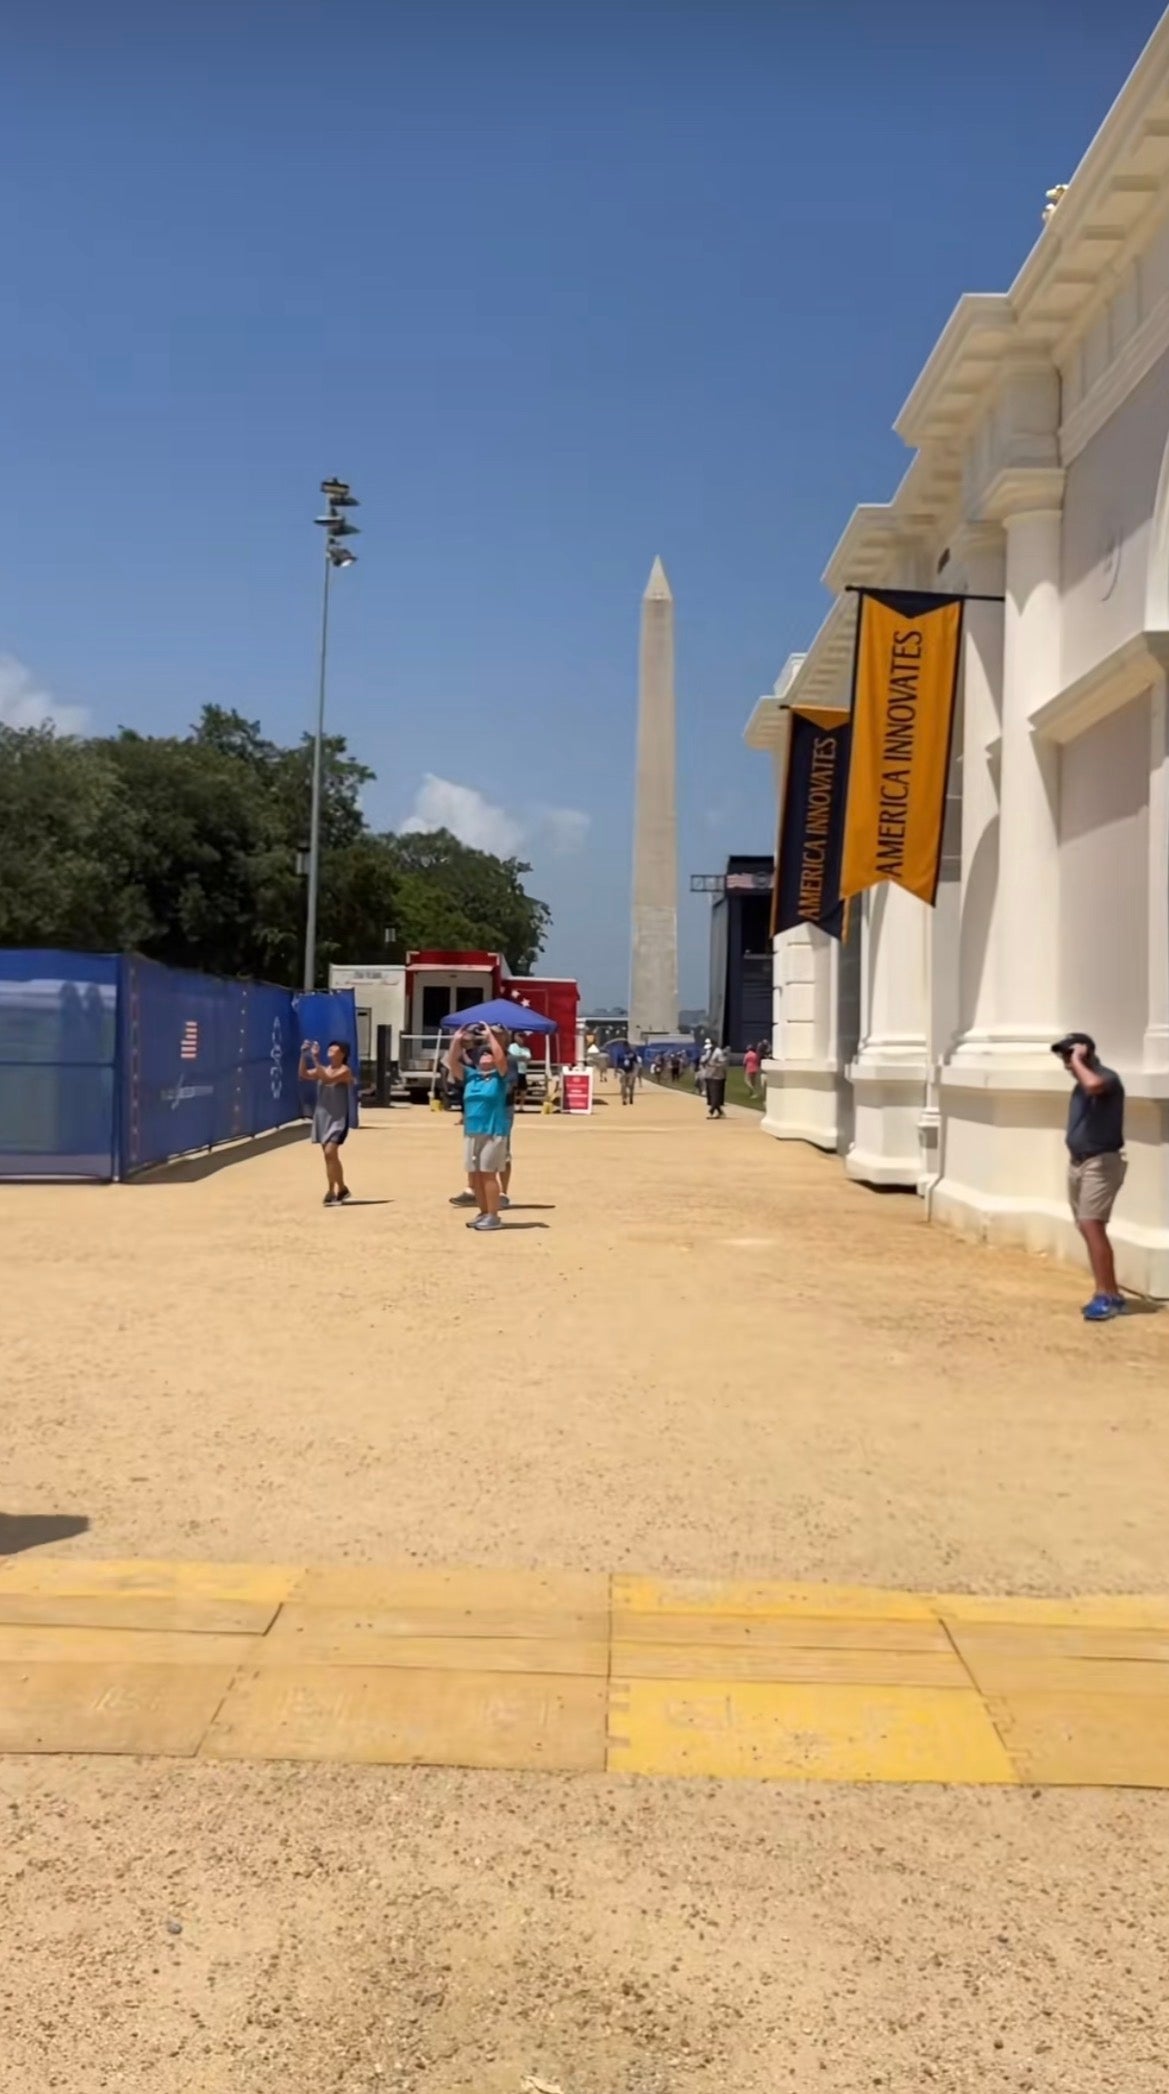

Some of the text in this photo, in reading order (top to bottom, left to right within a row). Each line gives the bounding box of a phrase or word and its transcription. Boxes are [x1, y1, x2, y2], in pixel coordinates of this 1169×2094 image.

[798, 737, 837, 921] AMERICA INNOVATES
[876, 630, 922, 878] AMERICA INNOVATES
